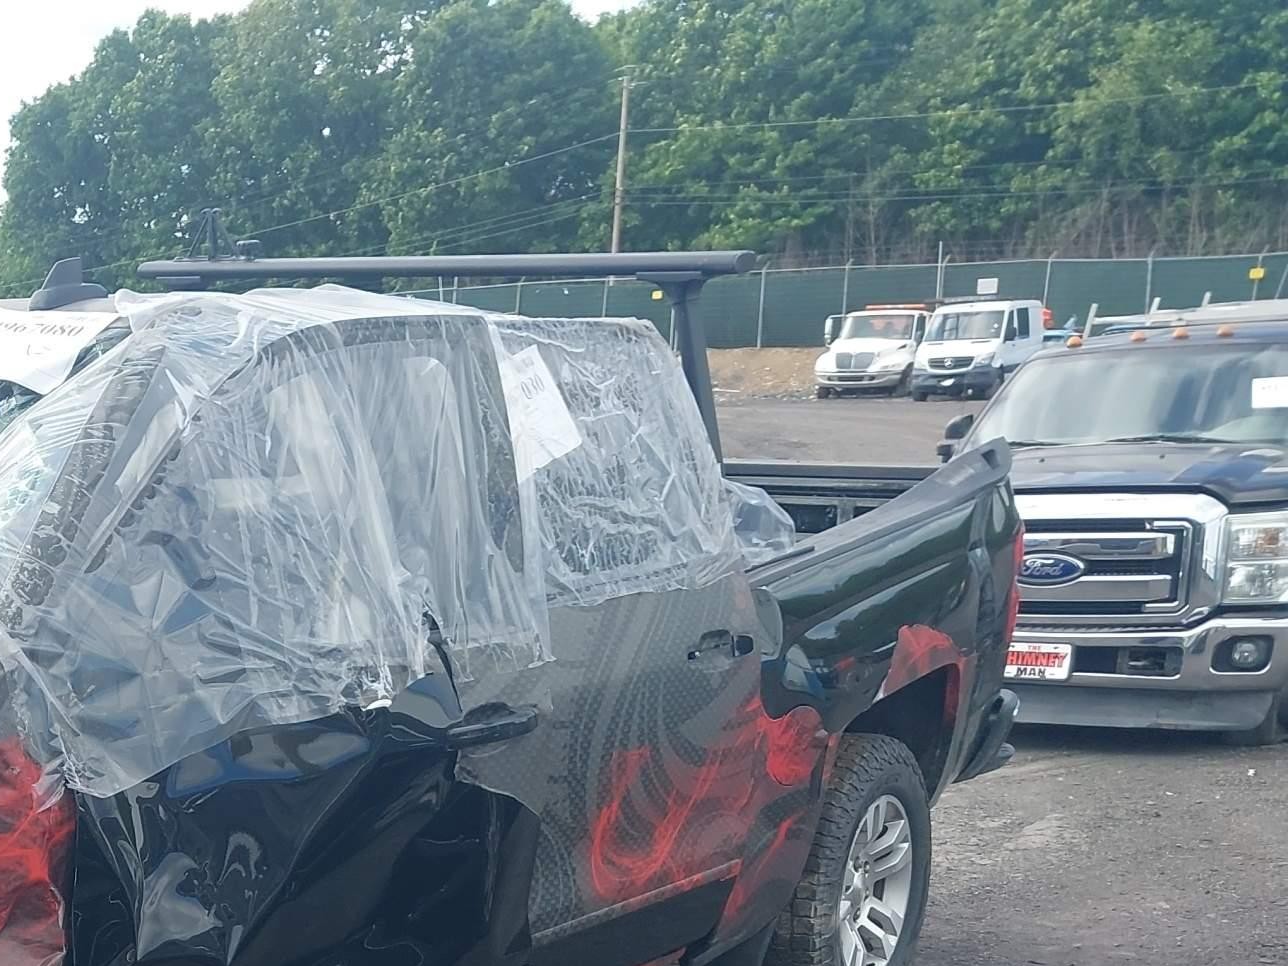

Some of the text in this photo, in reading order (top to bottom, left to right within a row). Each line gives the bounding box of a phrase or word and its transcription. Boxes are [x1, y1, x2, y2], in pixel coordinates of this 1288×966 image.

[1021, 558, 1065, 576] Ford
[1006, 651, 1068, 668] HIMNEY
[1015, 667, 1046, 677] MAN
